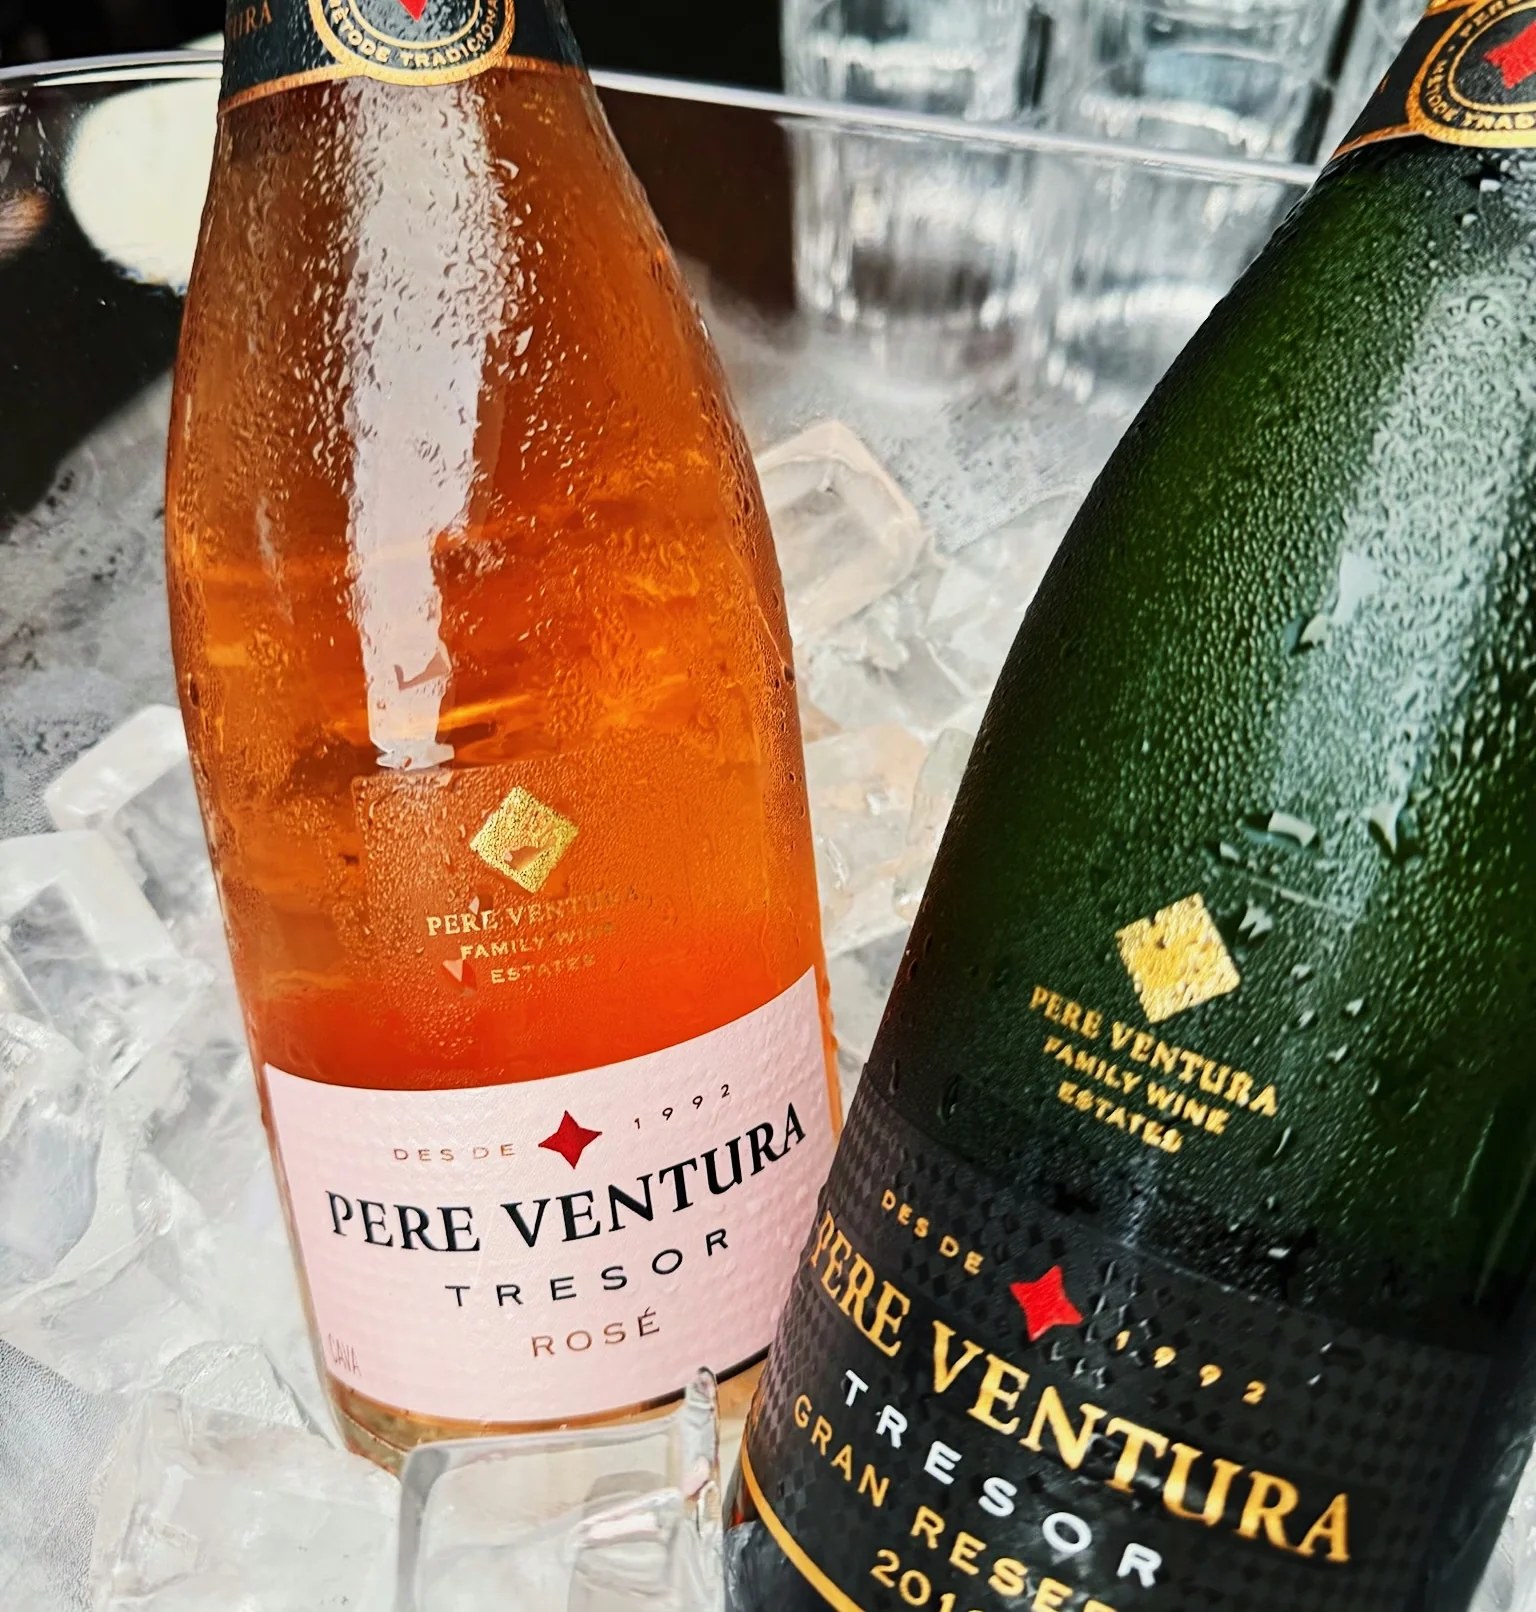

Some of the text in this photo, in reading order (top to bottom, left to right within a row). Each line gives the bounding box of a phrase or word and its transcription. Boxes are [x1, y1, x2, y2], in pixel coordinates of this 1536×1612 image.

[227, 0, 273, 40] URA
[426, 910, 499, 937] PERE
[460, 936, 545, 961] FAMILY
[1029, 985, 1278, 1117] PERE VENTURA
[1043, 1035, 1231, 1135] FAMILY WINE
[633, 1083, 731, 1130] 1992
[1057, 1080, 1184, 1153] ESTATES
[325, 1101, 807, 1252] PERE VENTURA
[444, 1227, 729, 1308] TRESOR
[328, 1332, 363, 1377] CAVA
[531, 1308, 660, 1358] ROSÉ
[1115, 1329, 1267, 1405] 1992
[811, 1209, 1351, 1563] PERE VENTURA
[793, 1394, 1118, 1612] GRAN RESE
[842, 1368, 1163, 1589] TRESOR
[869, 1549, 984, 1612] 201
